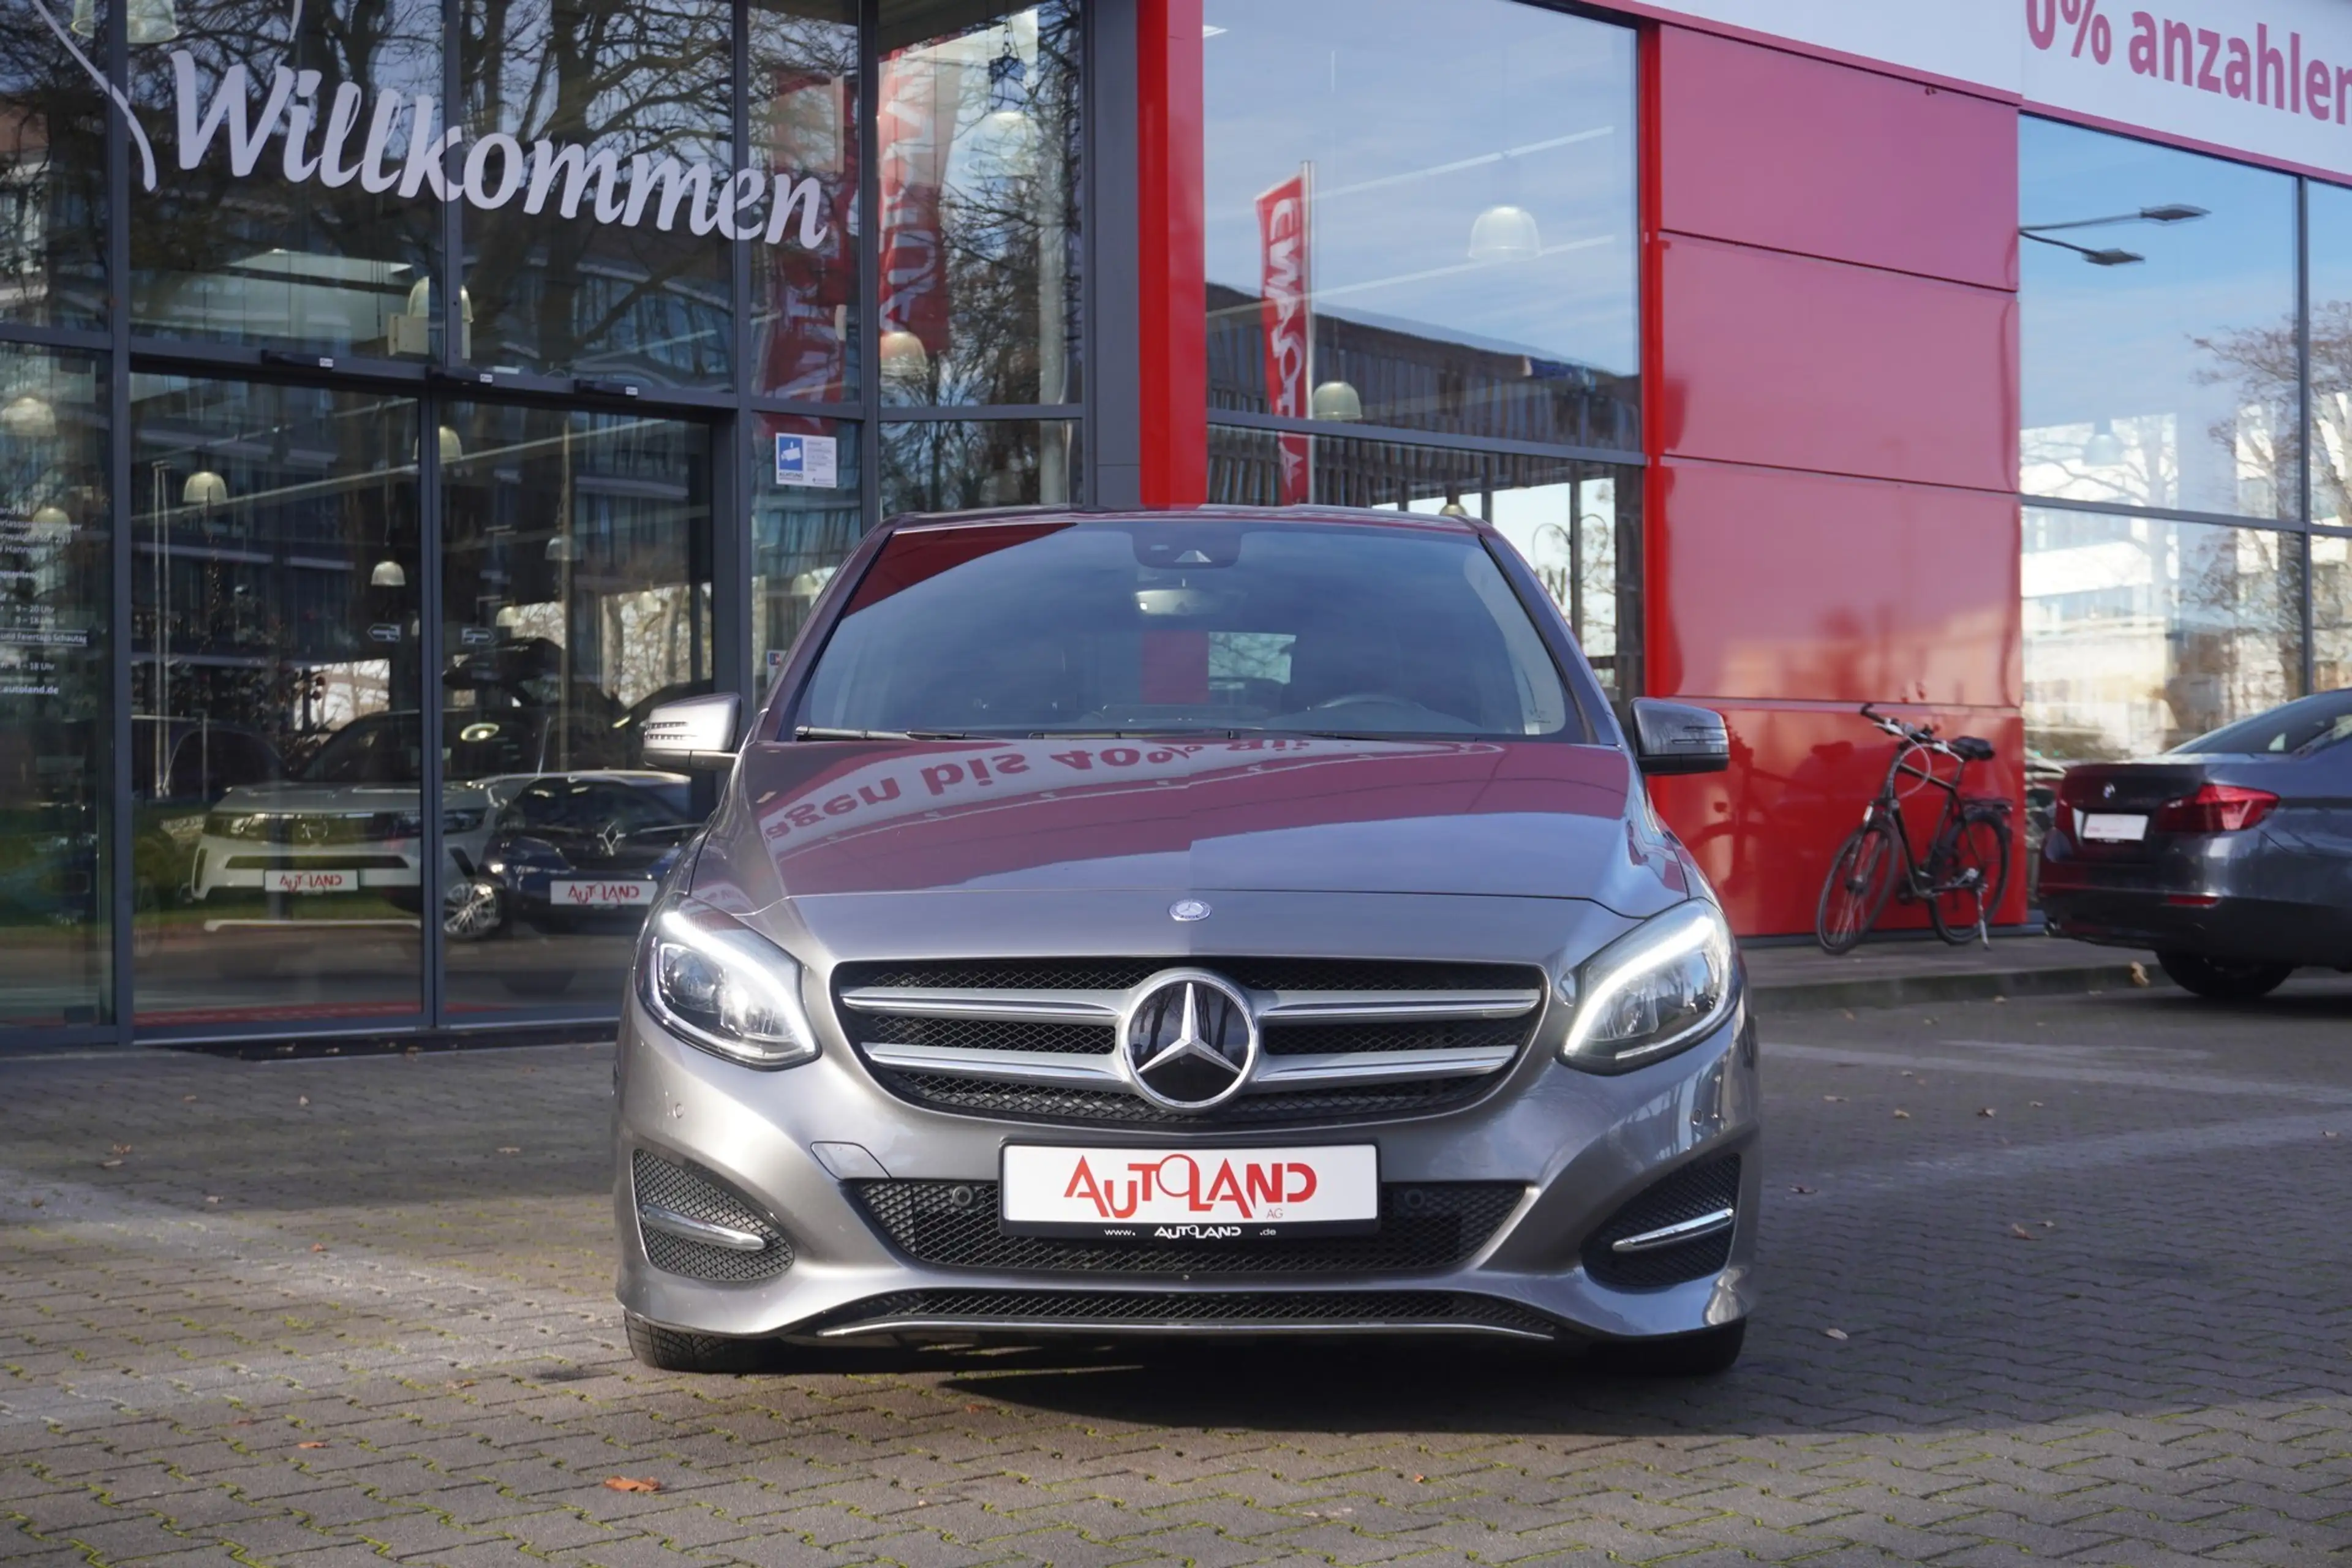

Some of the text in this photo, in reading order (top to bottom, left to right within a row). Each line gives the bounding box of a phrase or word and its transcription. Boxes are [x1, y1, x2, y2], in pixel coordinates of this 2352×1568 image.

[171, 49, 827, 249] Willkommen
[40, 605, 55, 614] Uhr
[40, 662, 55, 671] Uhr
[279, 872, 343, 893] AUTOLAND
[568, 881, 640, 905] AUTOLAND
[1063, 1153, 1317, 1219] AUTOLAND
[1265, 1207, 1284, 1219] AG
[1154, 1224, 1242, 1240] AUTOLAND
[1259, 1227, 1277, 1236] .de
